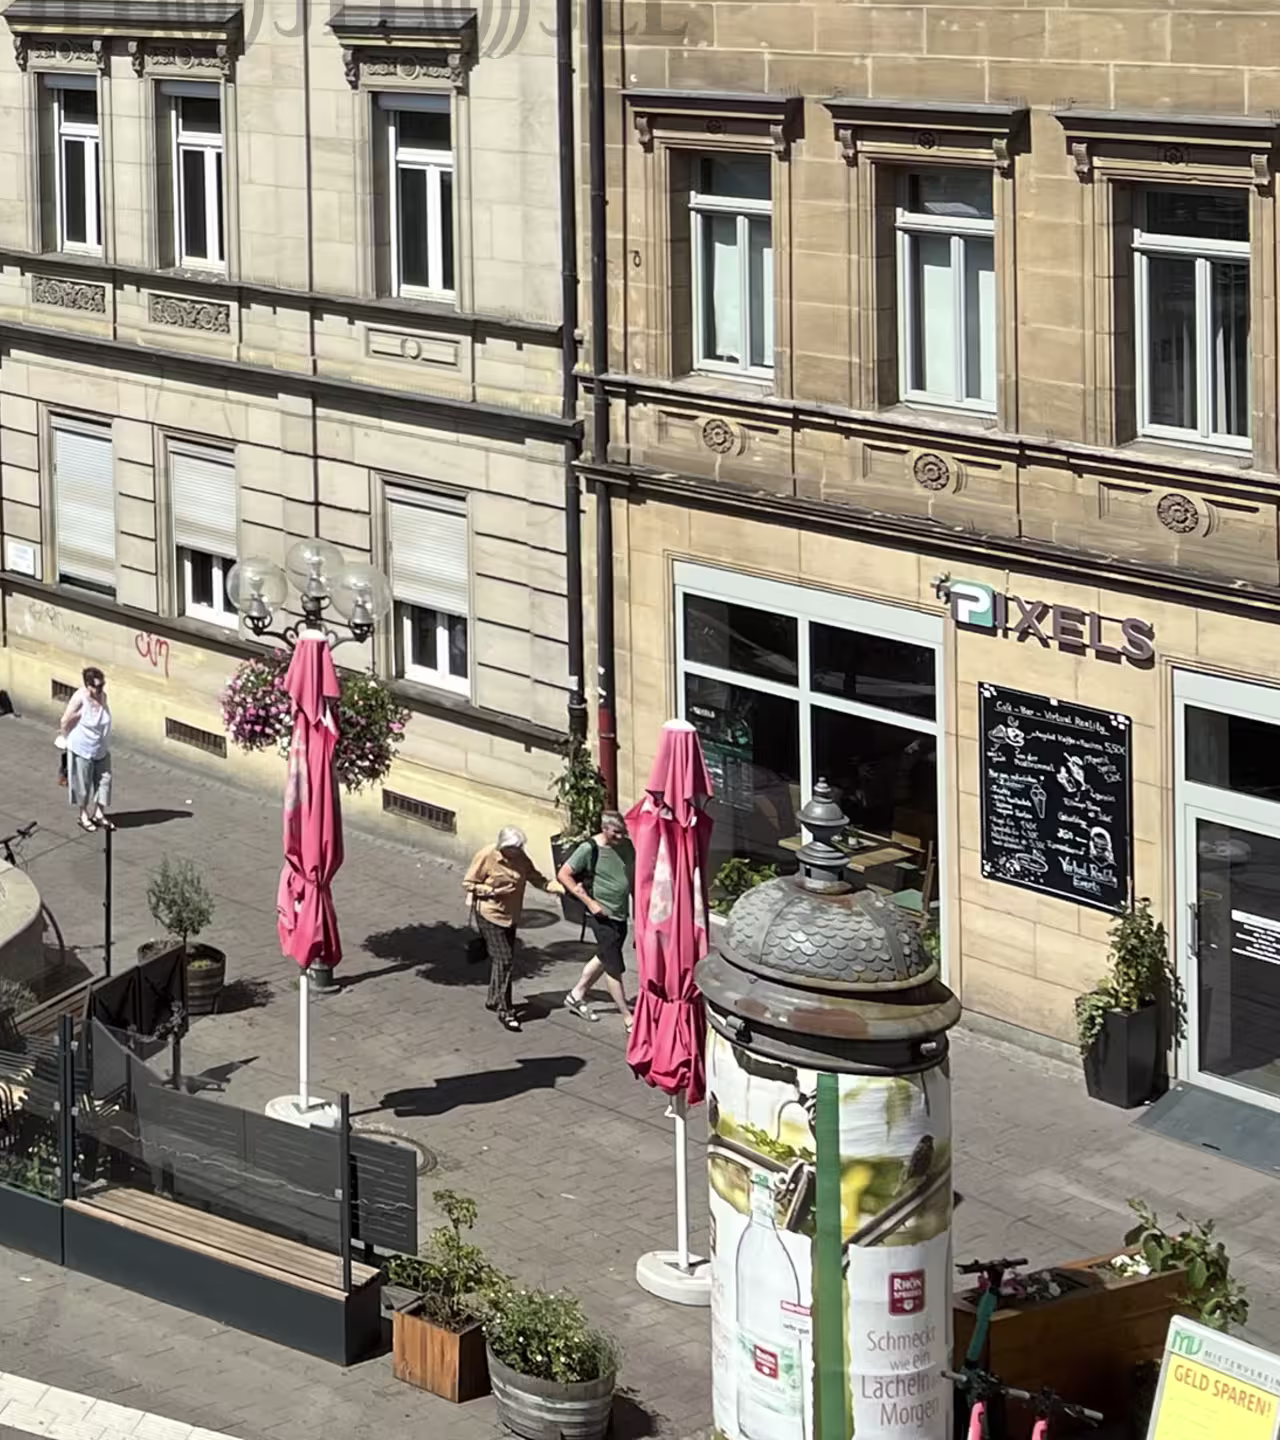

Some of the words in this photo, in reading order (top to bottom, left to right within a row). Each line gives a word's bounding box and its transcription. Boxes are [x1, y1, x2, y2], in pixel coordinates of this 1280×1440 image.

[949, 580, 1156, 662] PIXELS
[866, 1326, 937, 1352] Schmeckt
[861, 1372, 930, 1399] Lächeln
[1173, 1363, 1210, 1392] GELD
[1212, 1379, 1272, 1429] SPAREN!
[879, 1397, 939, 1428] Morgen
